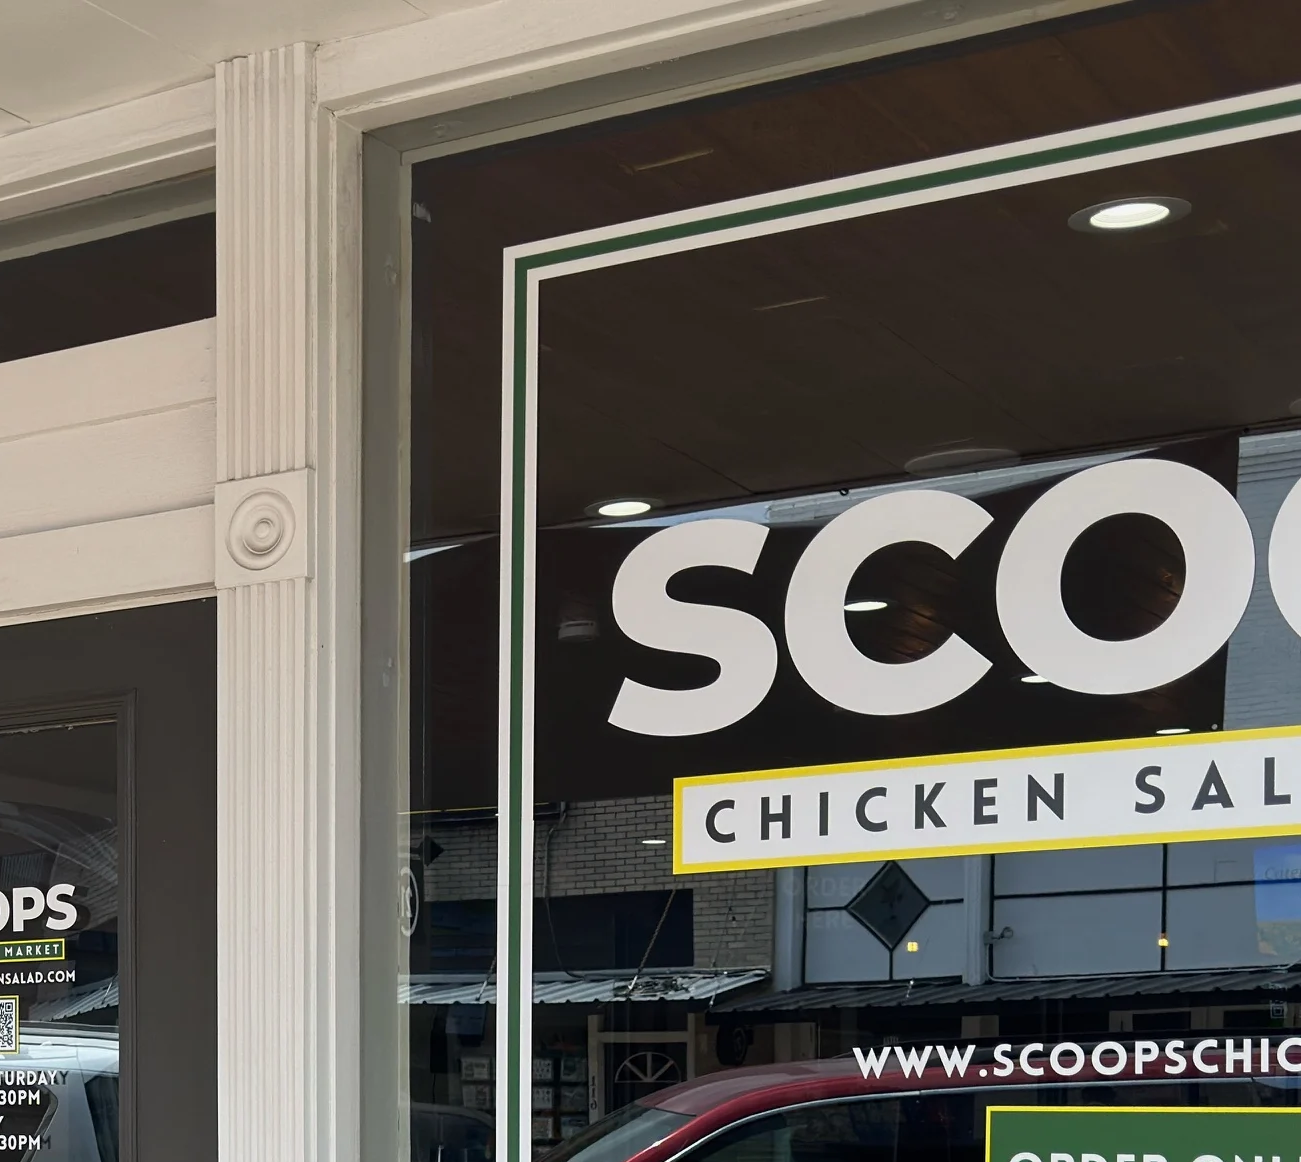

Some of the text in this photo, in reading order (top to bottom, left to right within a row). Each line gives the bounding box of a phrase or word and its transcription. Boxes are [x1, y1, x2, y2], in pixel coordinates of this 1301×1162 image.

[607, 458, 1301, 737] SCO
[704, 772, 1066, 843] CHICKEN
[5, 943, 60, 957] MARKET
